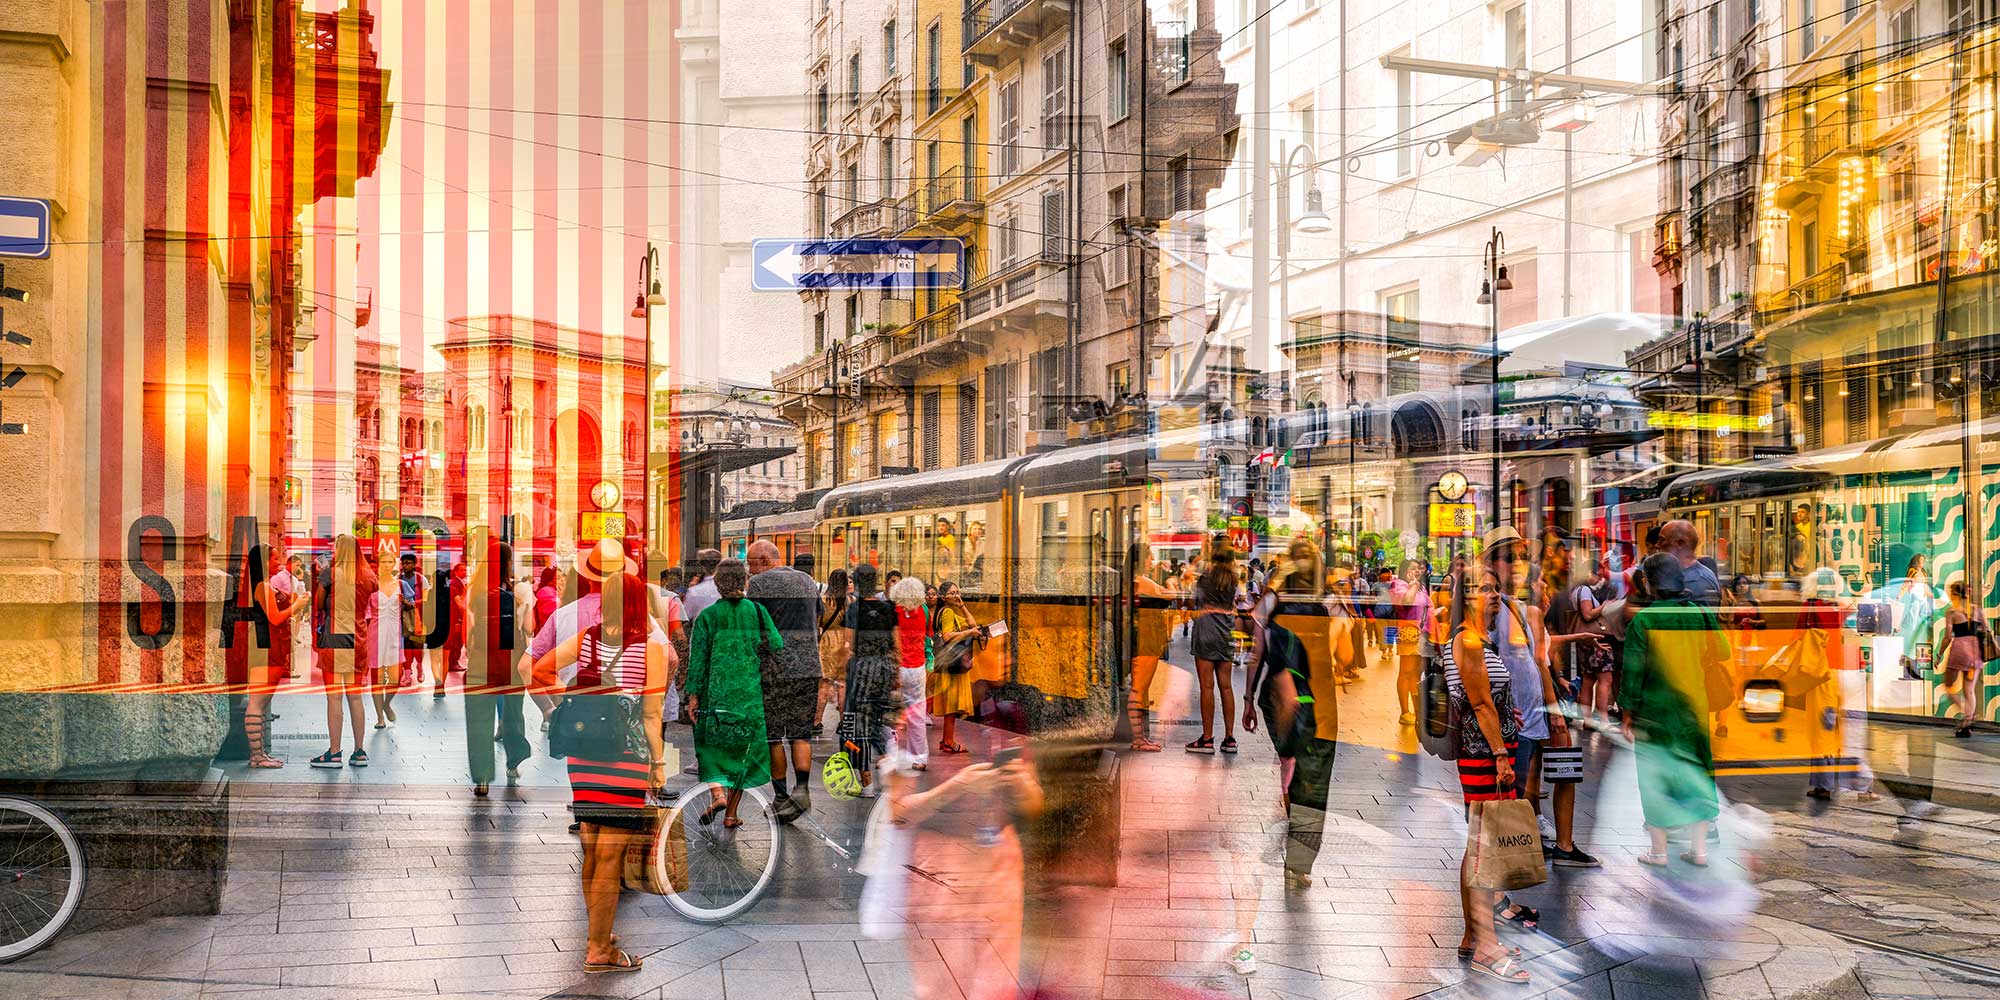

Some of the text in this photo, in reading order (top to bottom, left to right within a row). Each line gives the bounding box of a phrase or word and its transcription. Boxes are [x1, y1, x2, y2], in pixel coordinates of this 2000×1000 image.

[378, 538, 397, 552] M
[1232, 533, 1250, 548] M
[127, 515, 515, 651] SALDI
[1498, 834, 1533, 848] MANGO
